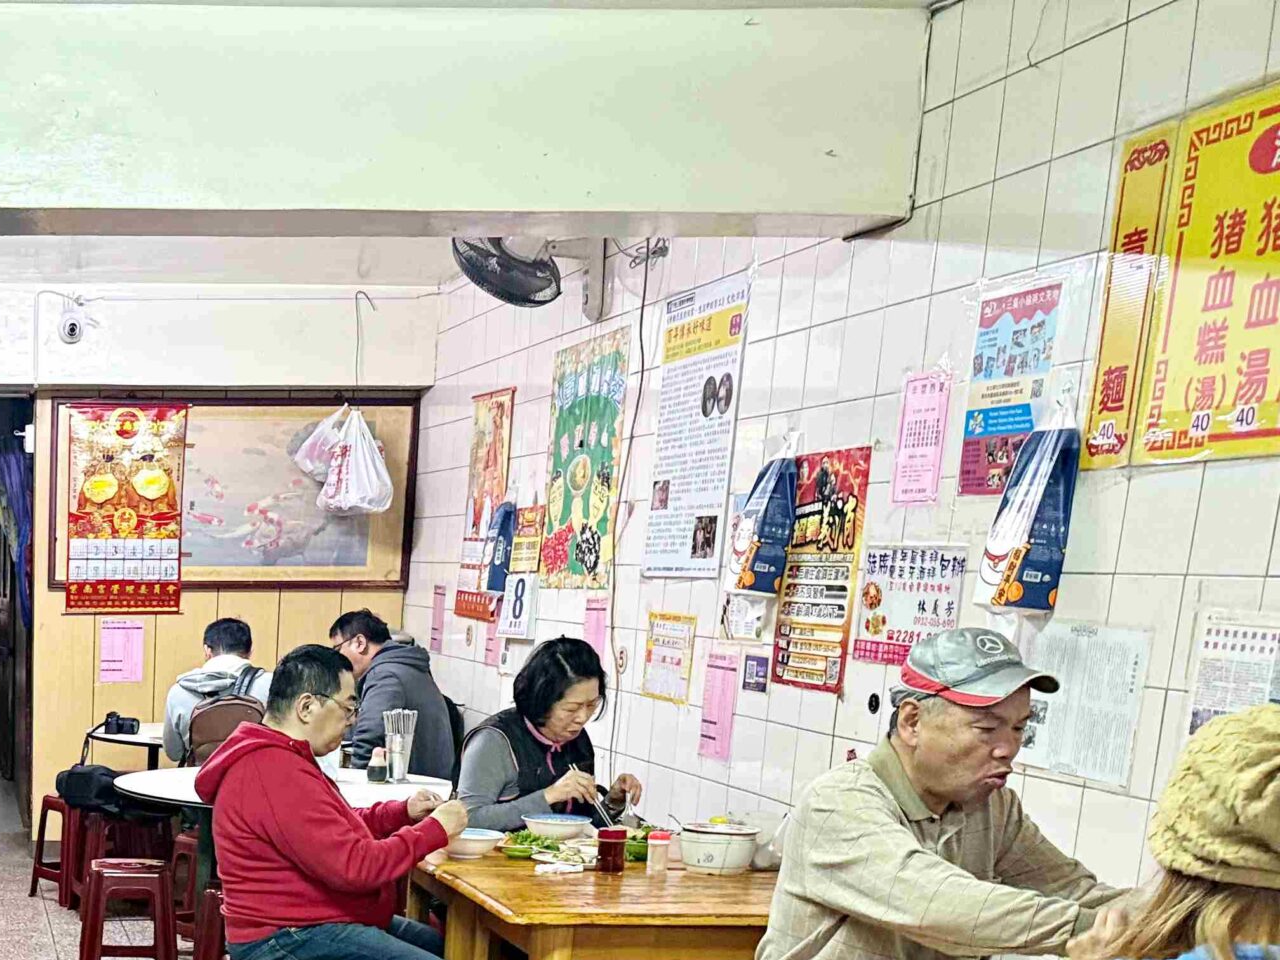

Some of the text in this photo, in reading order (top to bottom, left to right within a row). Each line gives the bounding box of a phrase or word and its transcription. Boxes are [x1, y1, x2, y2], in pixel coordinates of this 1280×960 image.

[1192, 413, 1210, 432] 40
[1236, 406, 1256, 427] 40
[1099, 421, 1114, 440] 40
[512, 578, 526, 620] 8
